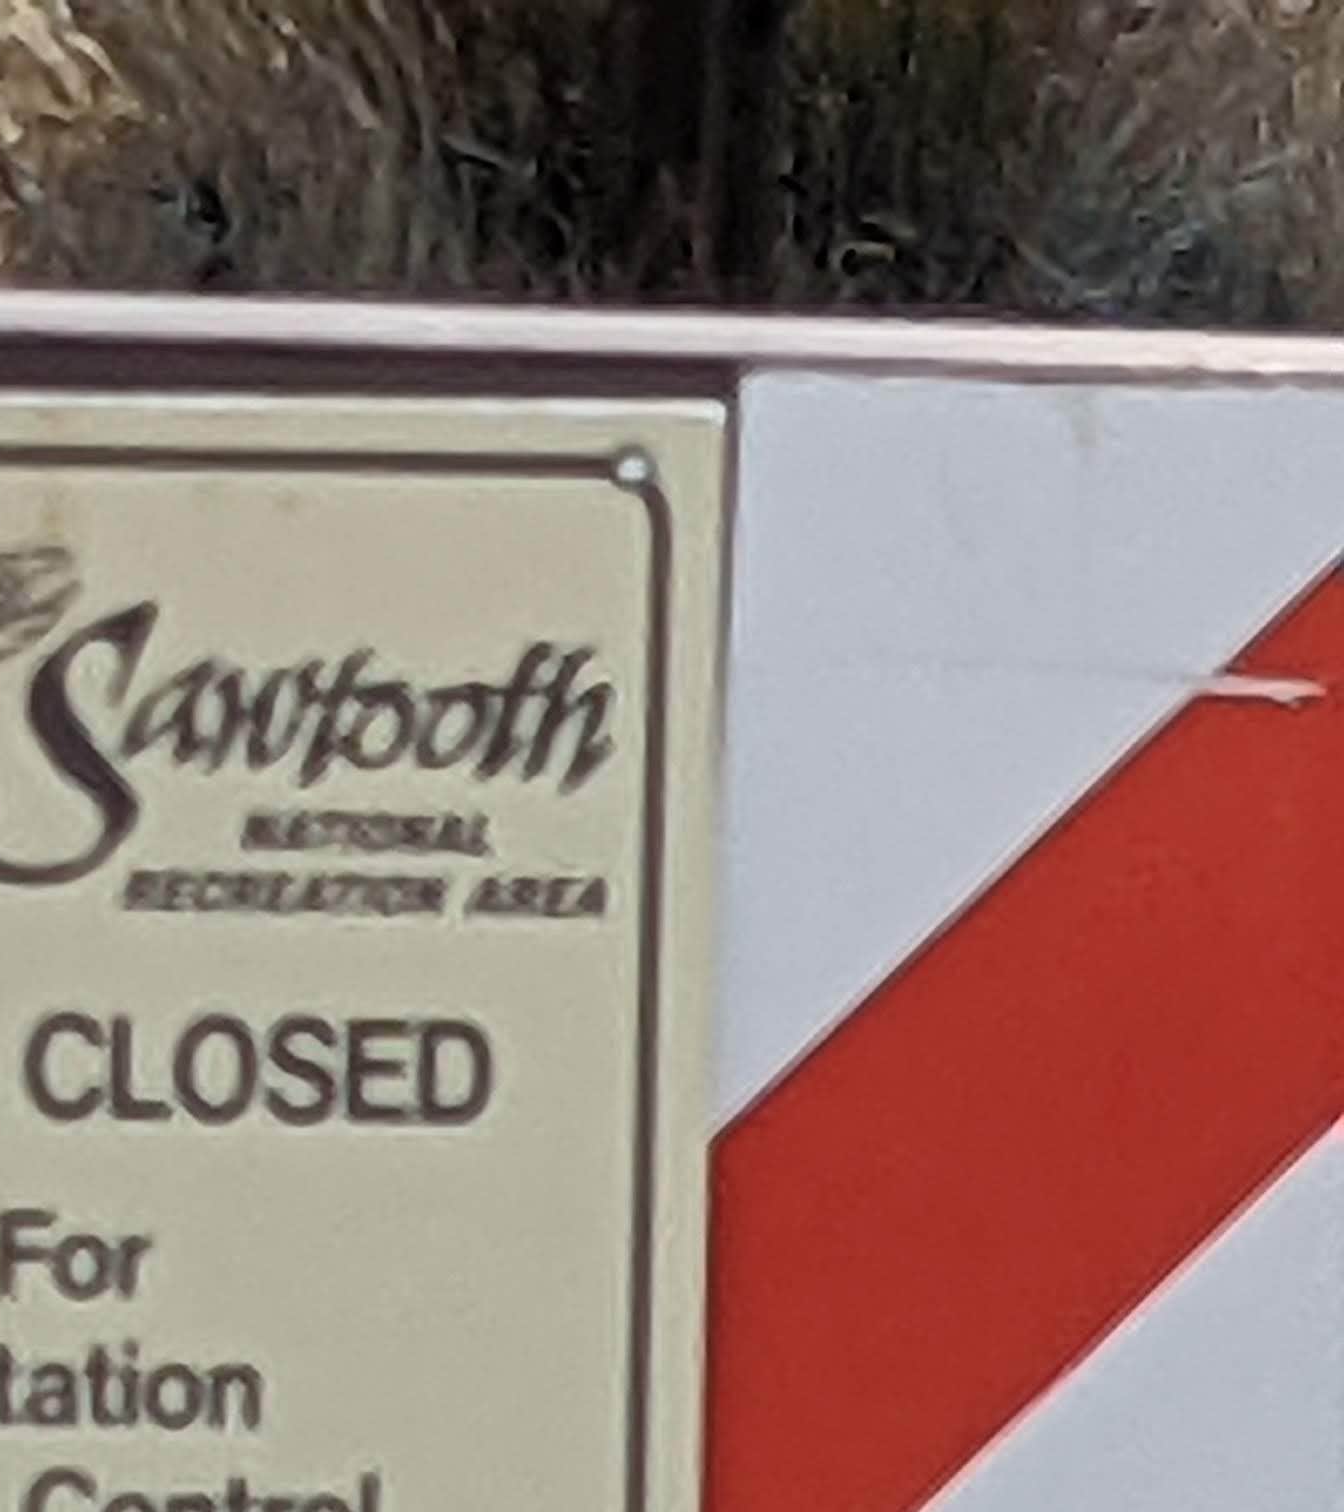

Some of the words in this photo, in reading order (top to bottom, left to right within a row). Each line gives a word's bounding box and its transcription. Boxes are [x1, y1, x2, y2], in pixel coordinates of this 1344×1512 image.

[240, 810, 492, 857] NATIONAL
[122, 870, 448, 914] RECREATION
[464, 876, 607, 918] AREA
[23, 1011, 493, 1126] CLOSED
